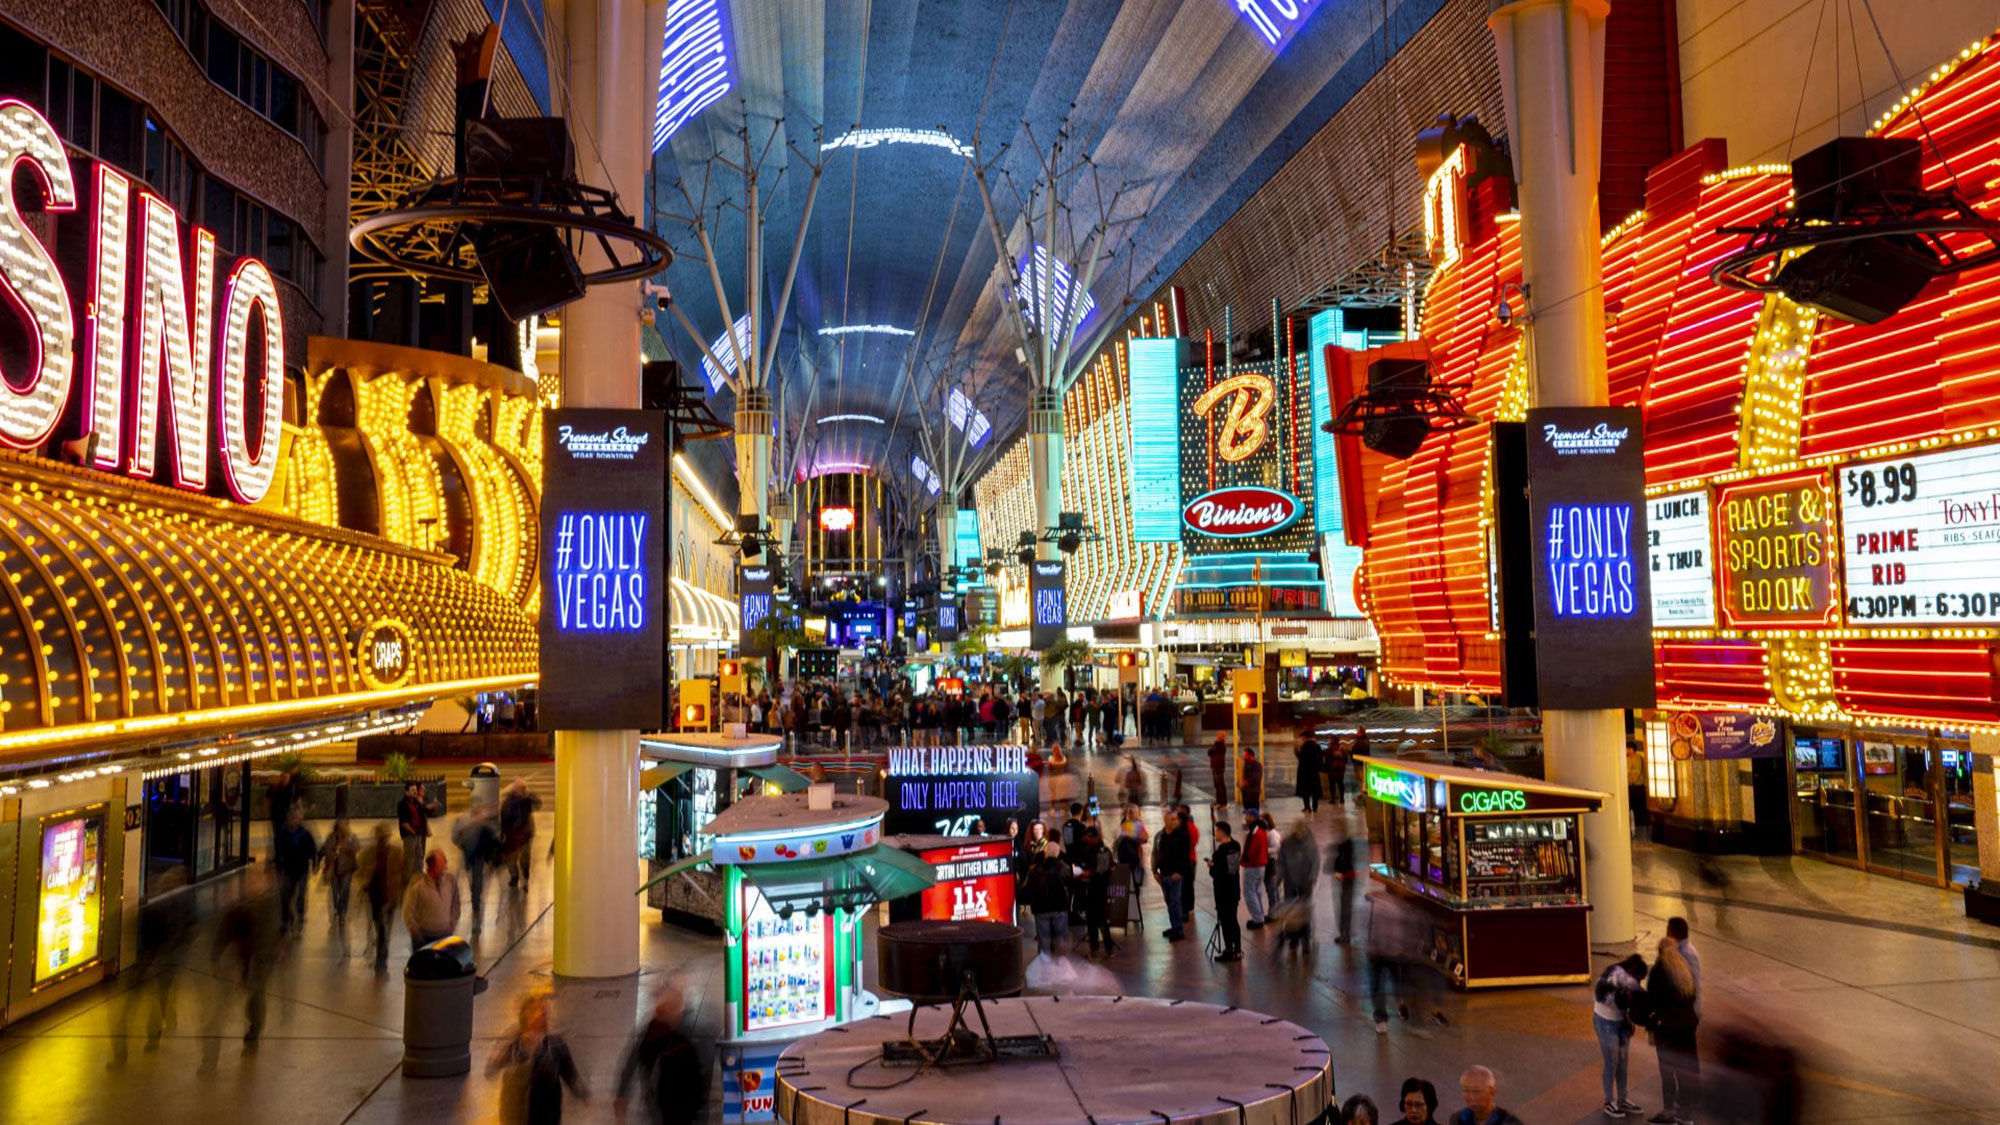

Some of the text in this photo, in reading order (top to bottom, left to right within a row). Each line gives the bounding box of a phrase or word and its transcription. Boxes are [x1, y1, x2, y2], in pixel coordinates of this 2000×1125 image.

[1193, 374, 1274, 461] B
[558, 425, 649, 444] Fremont Street
[1544, 422, 1629, 442] Fremont Street
[1847, 462, 1917, 508] $8.99
[1192, 500, 1286, 528] Binion's
[1655, 497, 1700, 520] LUNCH
[1727, 489, 1823, 532] RACE &
[556, 515, 645, 570] #ONLY
[1549, 507, 1630, 560] #ONLY
[1856, 528, 1919, 555] PRIME
[1944, 532, 1966, 543] RIBS
[1667, 549, 1704, 571] THUR
[1729, 532, 1821, 572] SPORTS
[1551, 561, 1633, 614] VEGAS
[1871, 562, 1907, 586] RIB
[557, 574, 643, 629] VEGAS
[744, 594, 770, 613] #ONLY
[1037, 589, 1062, 607] #ONLY
[1742, 576, 1813, 612] BOOK
[1848, 595, 1917, 619] 4:30PM
[1037, 606, 1063, 625] VEGAS
[374, 641, 402, 669] CRAPS
[888, 746, 927, 777] WHAT
[931, 745, 992, 776] HAPPENS
[901, 782, 929, 810] ONLY
[934, 781, 986, 809] HAPPENS
[1461, 790, 1526, 812] CIGARS
[956, 861, 981, 879] LUTHER
[982, 859, 999, 876] KING
[743, 1096, 774, 1113] FUN
